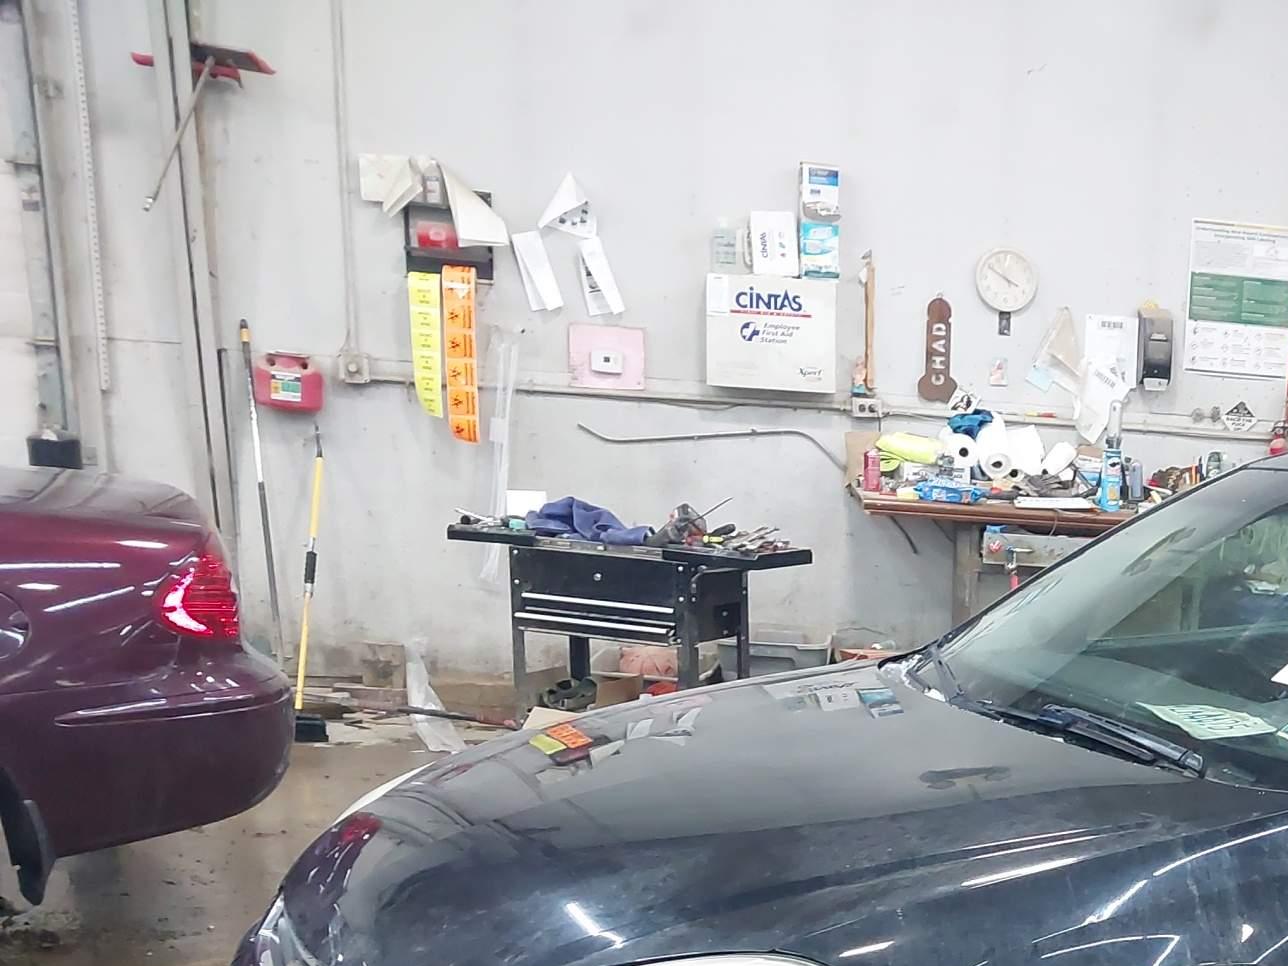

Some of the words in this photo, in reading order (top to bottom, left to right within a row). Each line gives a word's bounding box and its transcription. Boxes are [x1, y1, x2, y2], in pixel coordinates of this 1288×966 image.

[735, 286, 803, 312] CINTAS
[763, 322, 801, 331] Employee
[760, 336, 787, 344] Station
[931, 322, 947, 386] CHAD
